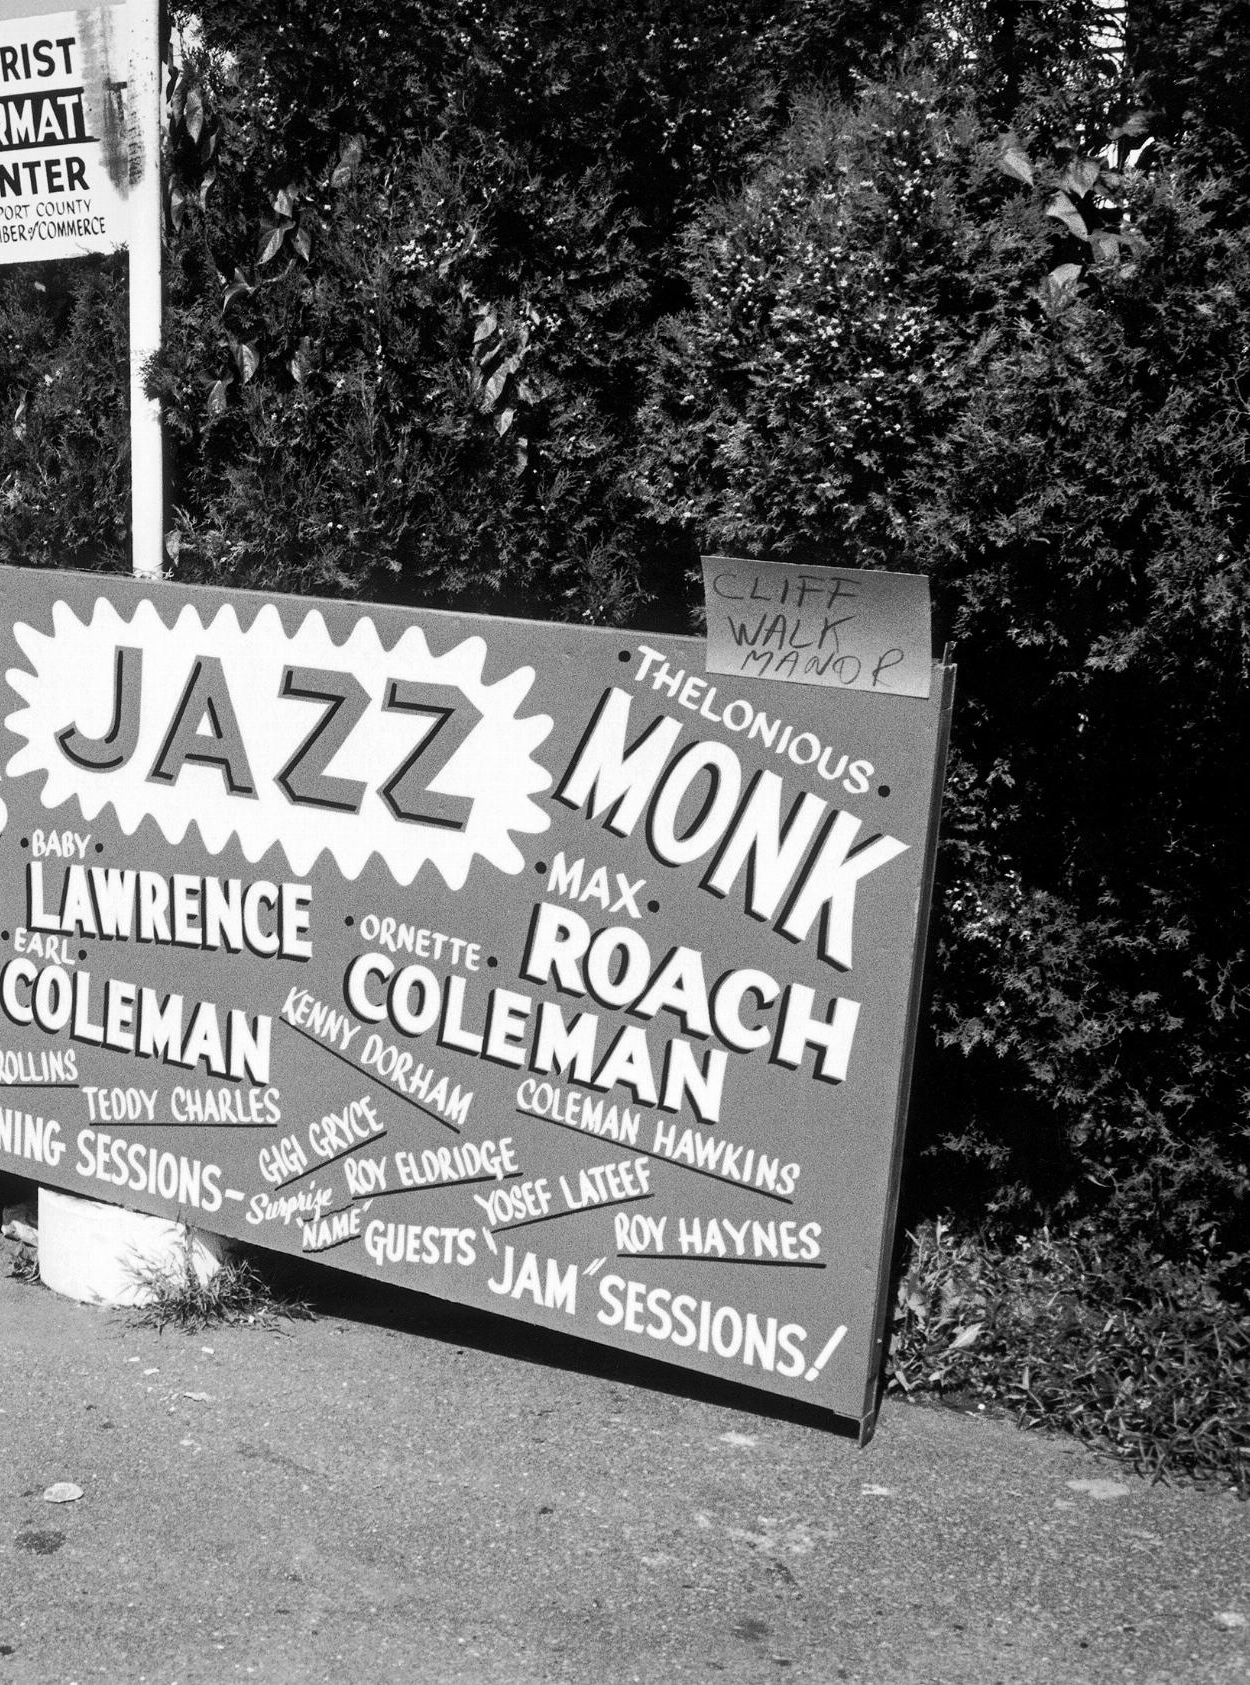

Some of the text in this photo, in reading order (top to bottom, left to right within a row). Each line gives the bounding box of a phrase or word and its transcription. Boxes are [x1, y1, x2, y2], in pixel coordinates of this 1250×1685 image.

[28, 220, 39, 241] of
[38, 217, 106, 241] COMMERCE
[36, 199, 91, 217] COUNTY
[713, 573, 861, 609] CLIFF
[727, 612, 855, 653] WALK
[741, 648, 904, 686] MANOR
[53, 644, 485, 833] JAZZ
[634, 645, 875, 795] THELONIOUS
[32, 829, 91, 859] BABY
[552, 687, 911, 973] MONK
[27, 861, 313, 962] LAWRENCE
[547, 851, 646, 918] MAX
[14, 927, 75, 965] EARL
[360, 914, 481, 971] ORNETTE
[0, 957, 272, 1087] COLEMAN
[519, 901, 861, 1085] ROACH
[282, 987, 474, 1124] KENNY DORHAM
[343, 952, 729, 1126] COLEMAN
[82, 1085, 281, 1124] TEDDY CHARLES
[516, 1078, 800, 1195] COLEMAN HAWKINS
[259, 1096, 384, 1184] GIGI GRYCE
[344, 1137, 519, 1195] ROY ELDRIDGE
[474, 1157, 651, 1226] YOSEF LATEEF
[614, 1212, 822, 1260] ROY HAYNES
[245, 1180, 332, 1225] Surprise
[364, 1220, 477, 1266] GUESTS
[597, 1274, 848, 1382] SESSIONS!
